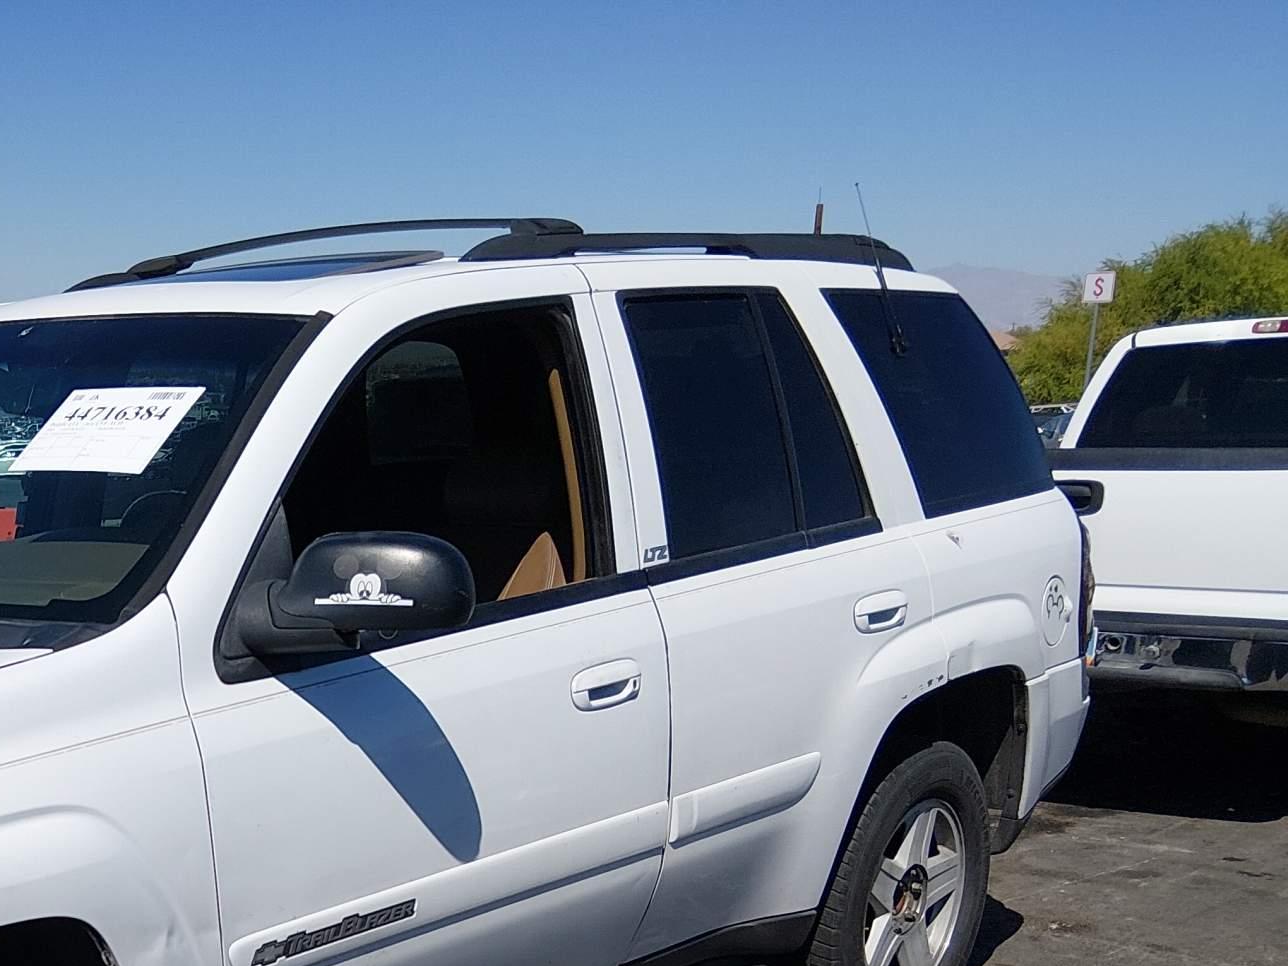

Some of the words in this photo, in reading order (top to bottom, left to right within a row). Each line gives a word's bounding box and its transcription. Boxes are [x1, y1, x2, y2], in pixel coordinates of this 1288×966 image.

[1093, 277, 1105, 297] S
[64, 405, 172, 422] 44716384
[643, 544, 668, 564] LTZ
